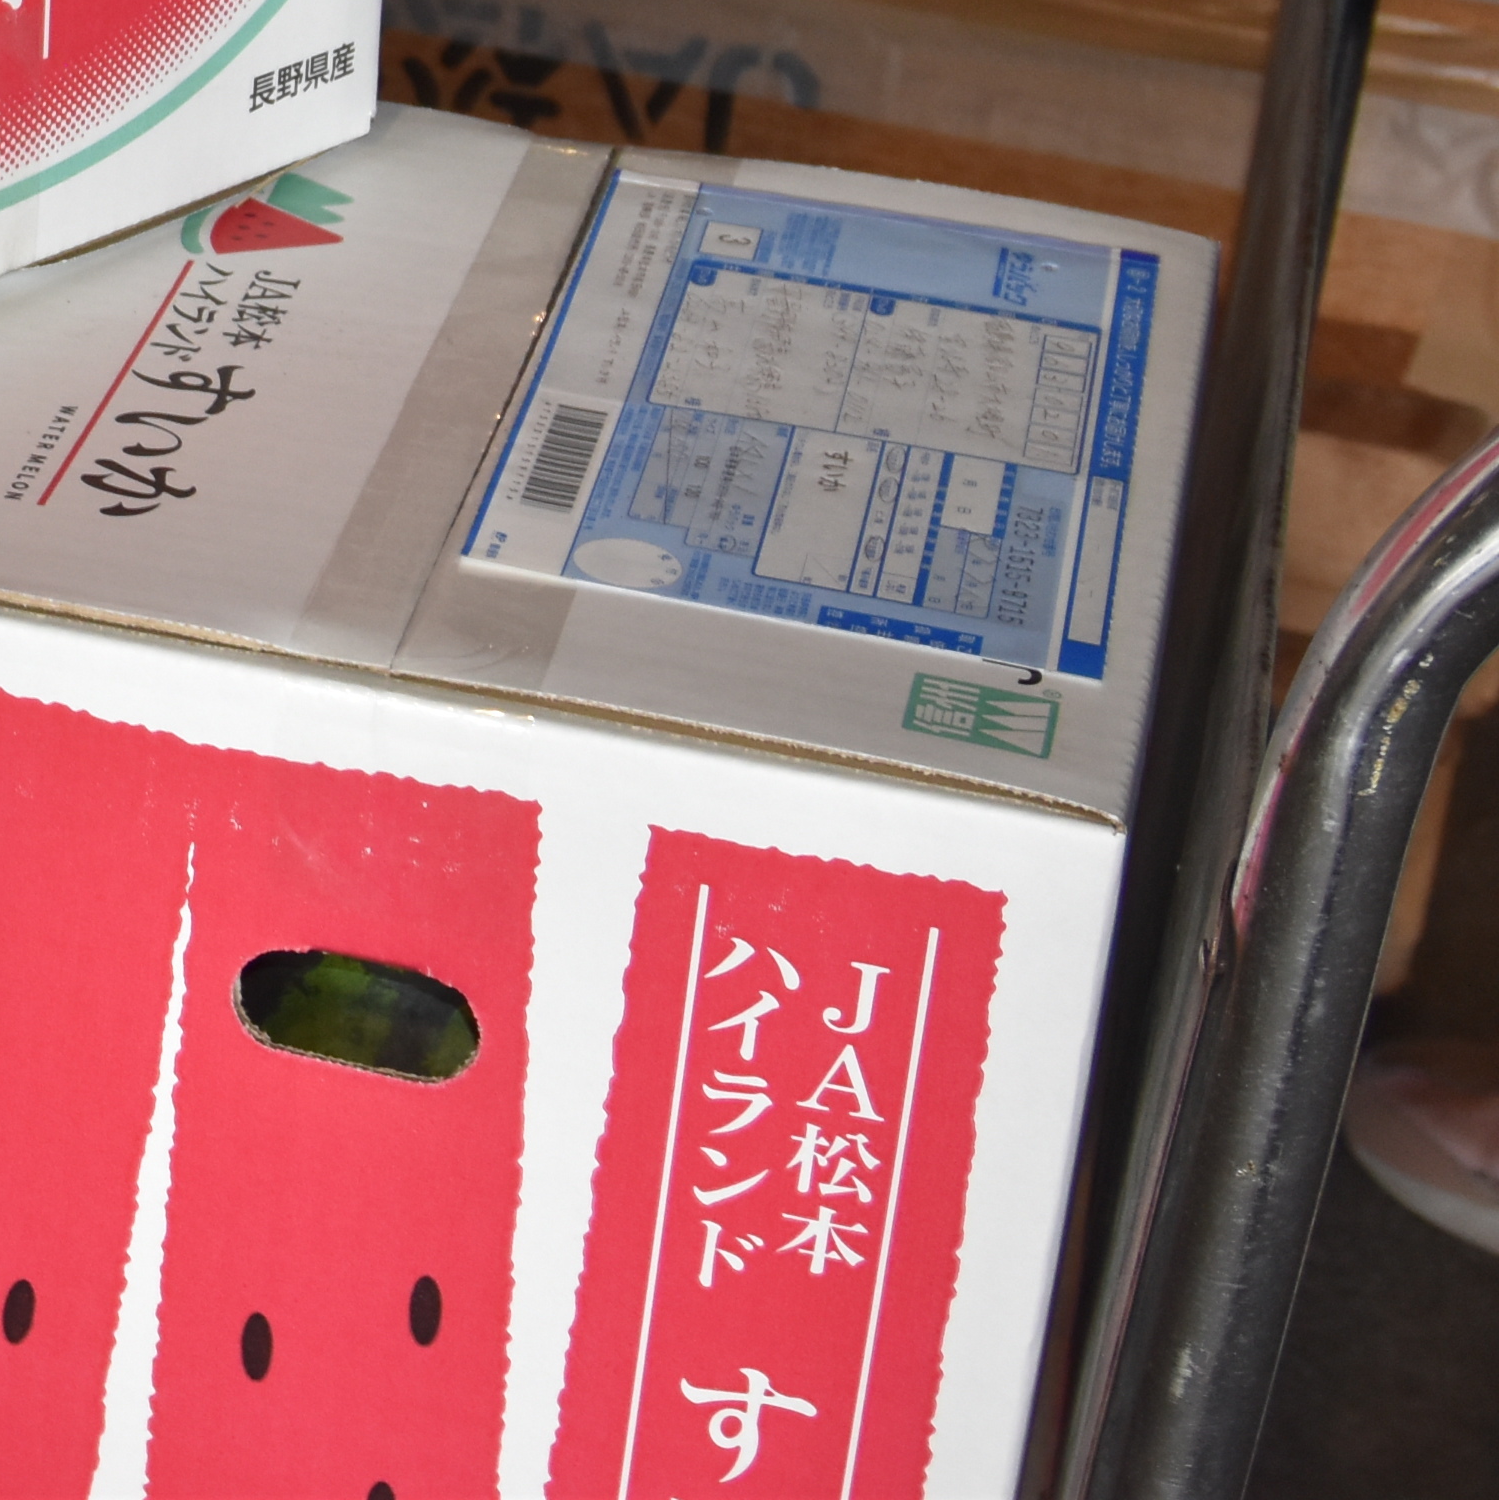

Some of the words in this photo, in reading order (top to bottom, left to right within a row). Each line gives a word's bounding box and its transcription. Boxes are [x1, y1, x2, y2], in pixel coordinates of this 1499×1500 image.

[248, 41, 356, 113] 長野県産
[150, 262, 234, 362] ハイランド
[222, 269, 301, 350] JA松本
[80, 365, 257, 517] すいか
[692, 937, 801, 1288] ハイランド
[778, 961, 891, 1275] JA松本
[663, 1367, 818, 1500] す
